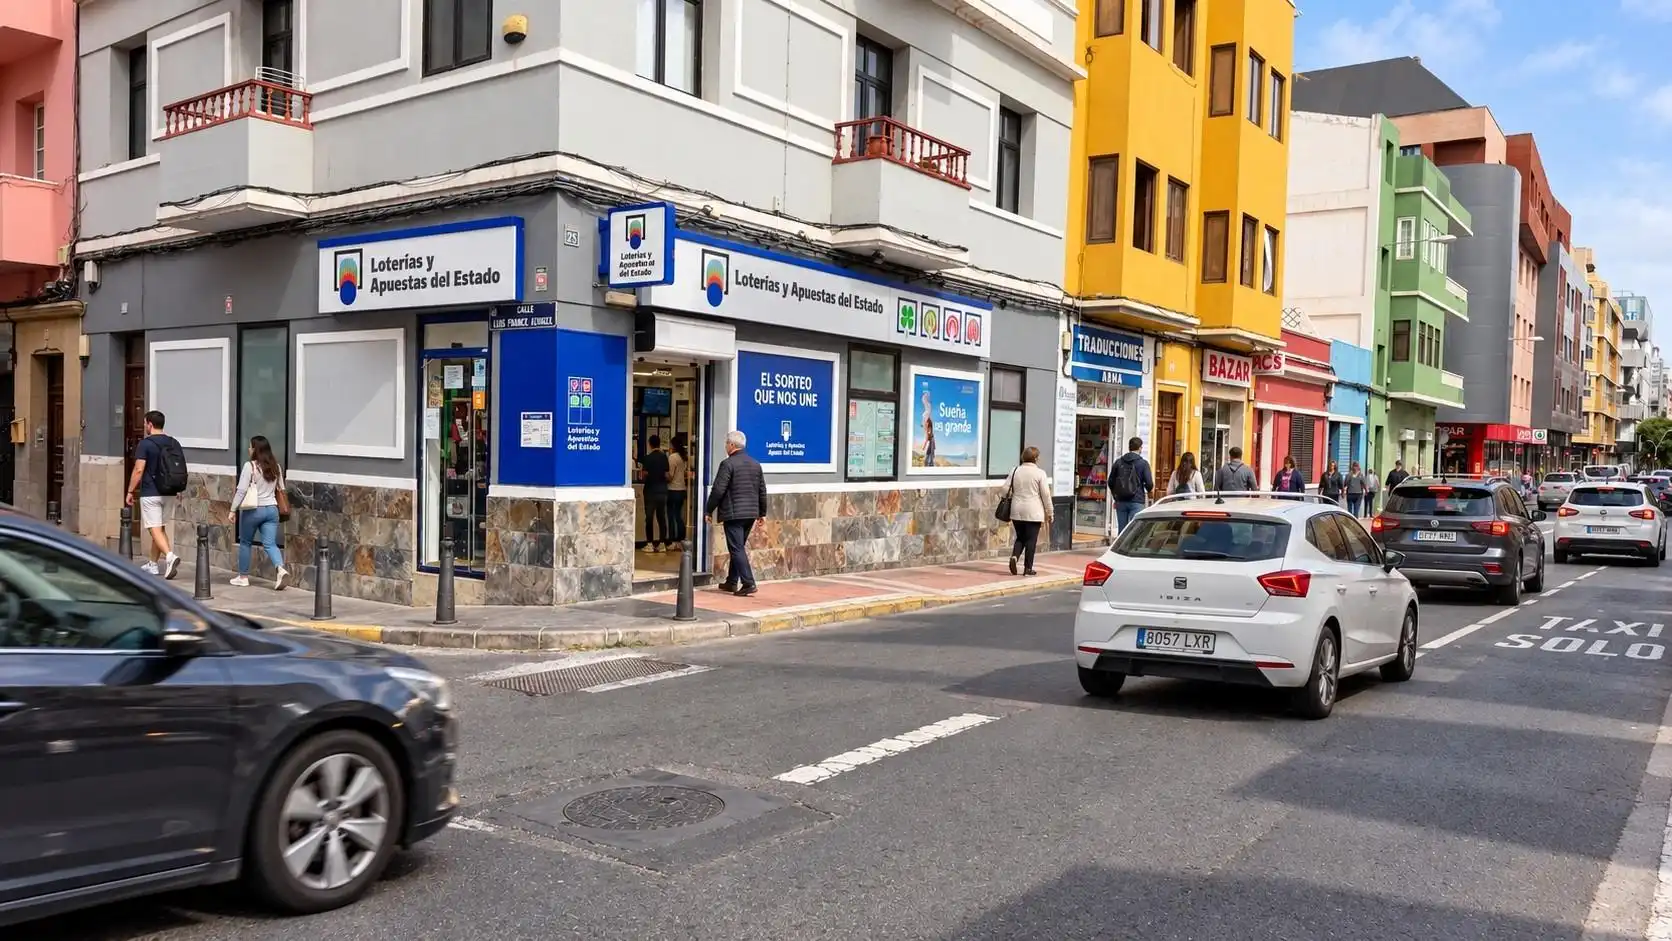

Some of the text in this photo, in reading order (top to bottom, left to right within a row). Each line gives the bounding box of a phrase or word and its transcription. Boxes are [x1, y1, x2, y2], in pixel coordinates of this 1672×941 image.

[371, 253, 435, 273] Loterías y
[647, 252, 653, 260] y
[370, 267, 501, 296] Apuestas del Estado
[735, 269, 884, 314] Loterías y Apuestas del Estado
[516, 305, 534, 314] CALLE
[1077, 334, 1144, 361] TRADUCCIONES
[1209, 354, 1250, 382] BAZAR
[761, 372, 812, 390] EL SORTEO
[754, 388, 818, 407] QUE NOS UNE
[945, 420, 971, 436] grande
[1539, 615, 1665, 638] TAXI
[1146, 631, 1211, 648] 8057 LXR
[1494, 634, 1665, 660] SOLO
